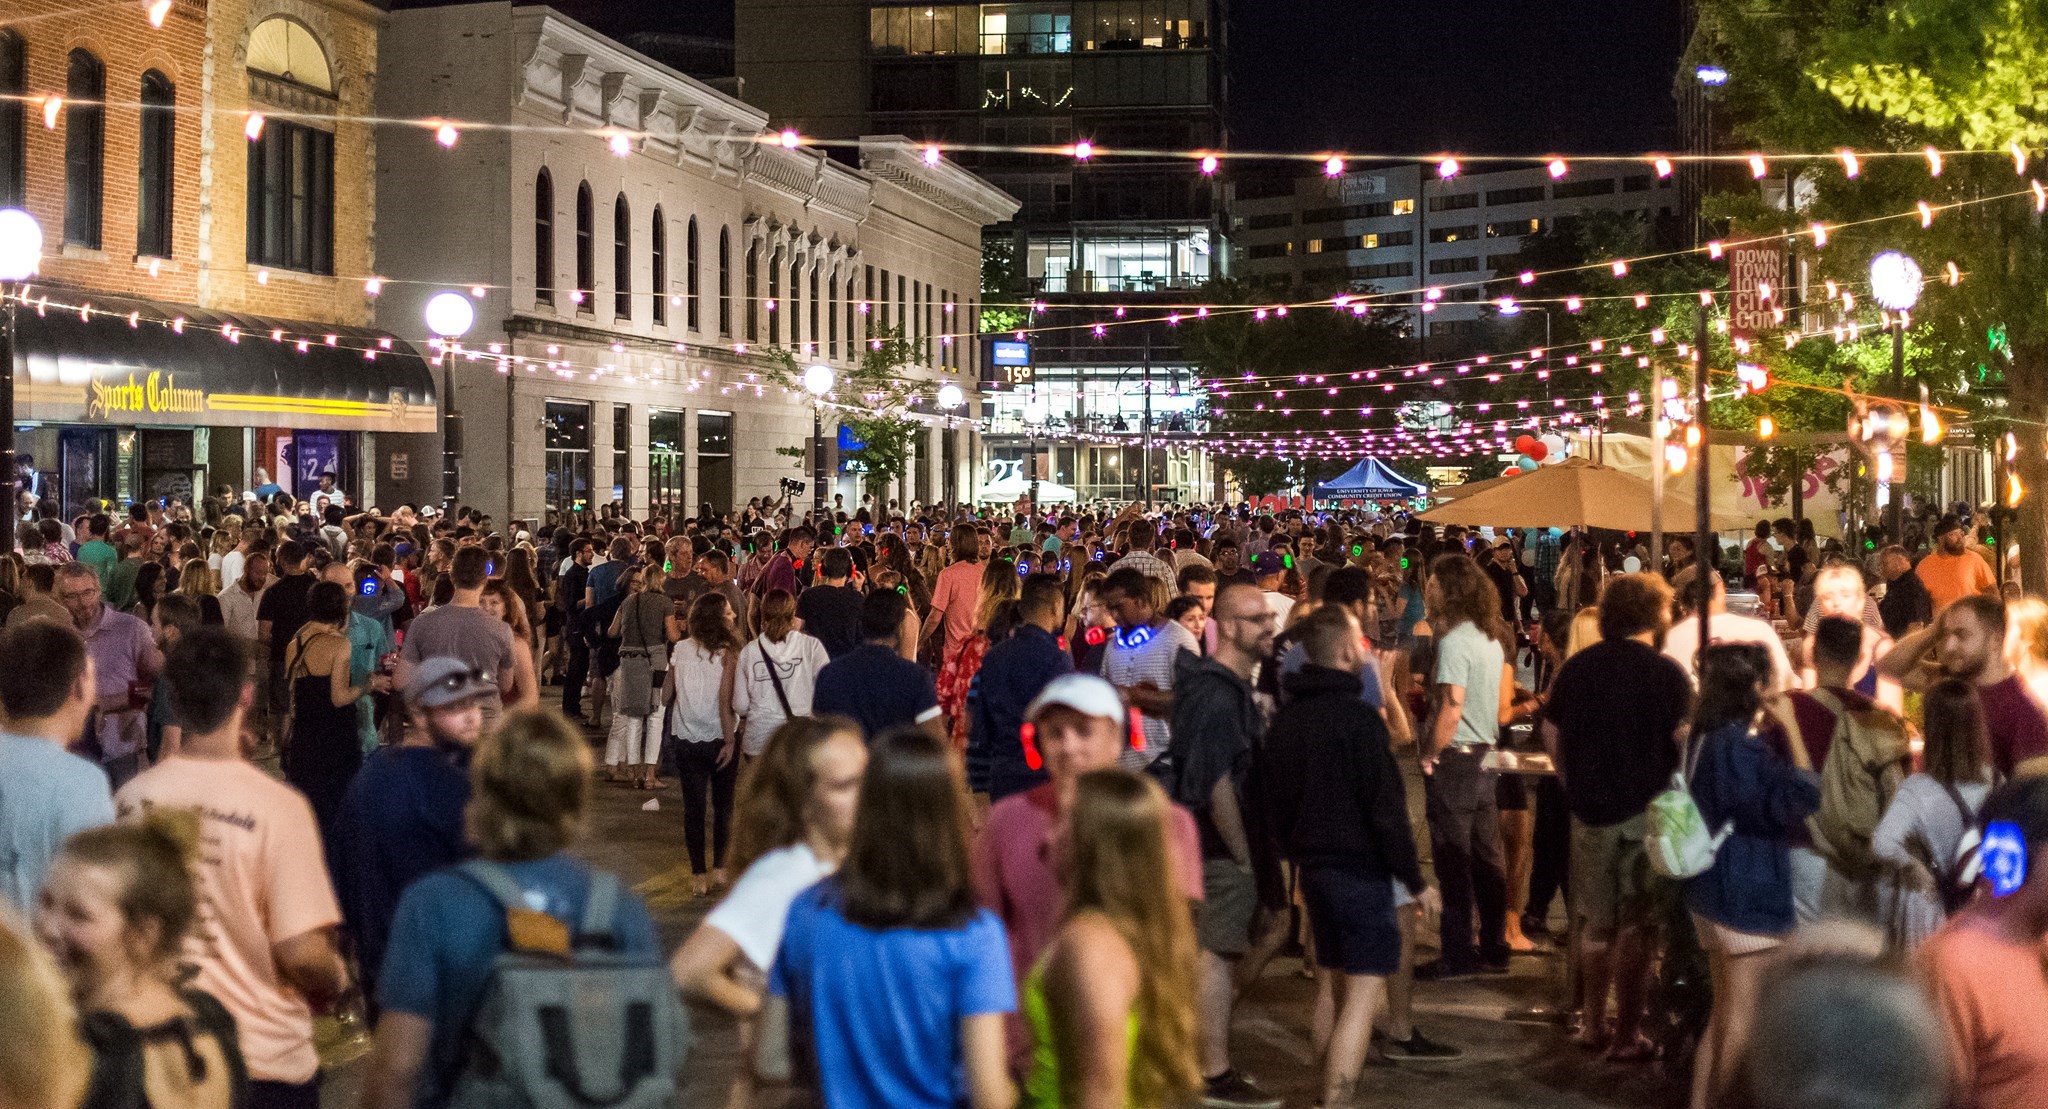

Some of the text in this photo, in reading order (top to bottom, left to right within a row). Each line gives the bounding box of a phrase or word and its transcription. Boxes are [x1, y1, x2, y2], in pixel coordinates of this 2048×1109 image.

[1736, 249, 1780, 263] DOWN
[1735, 263, 1780, 277] TOWN
[1736, 293, 1780, 310] CITY
[90, 369, 204, 418] Sports Column
